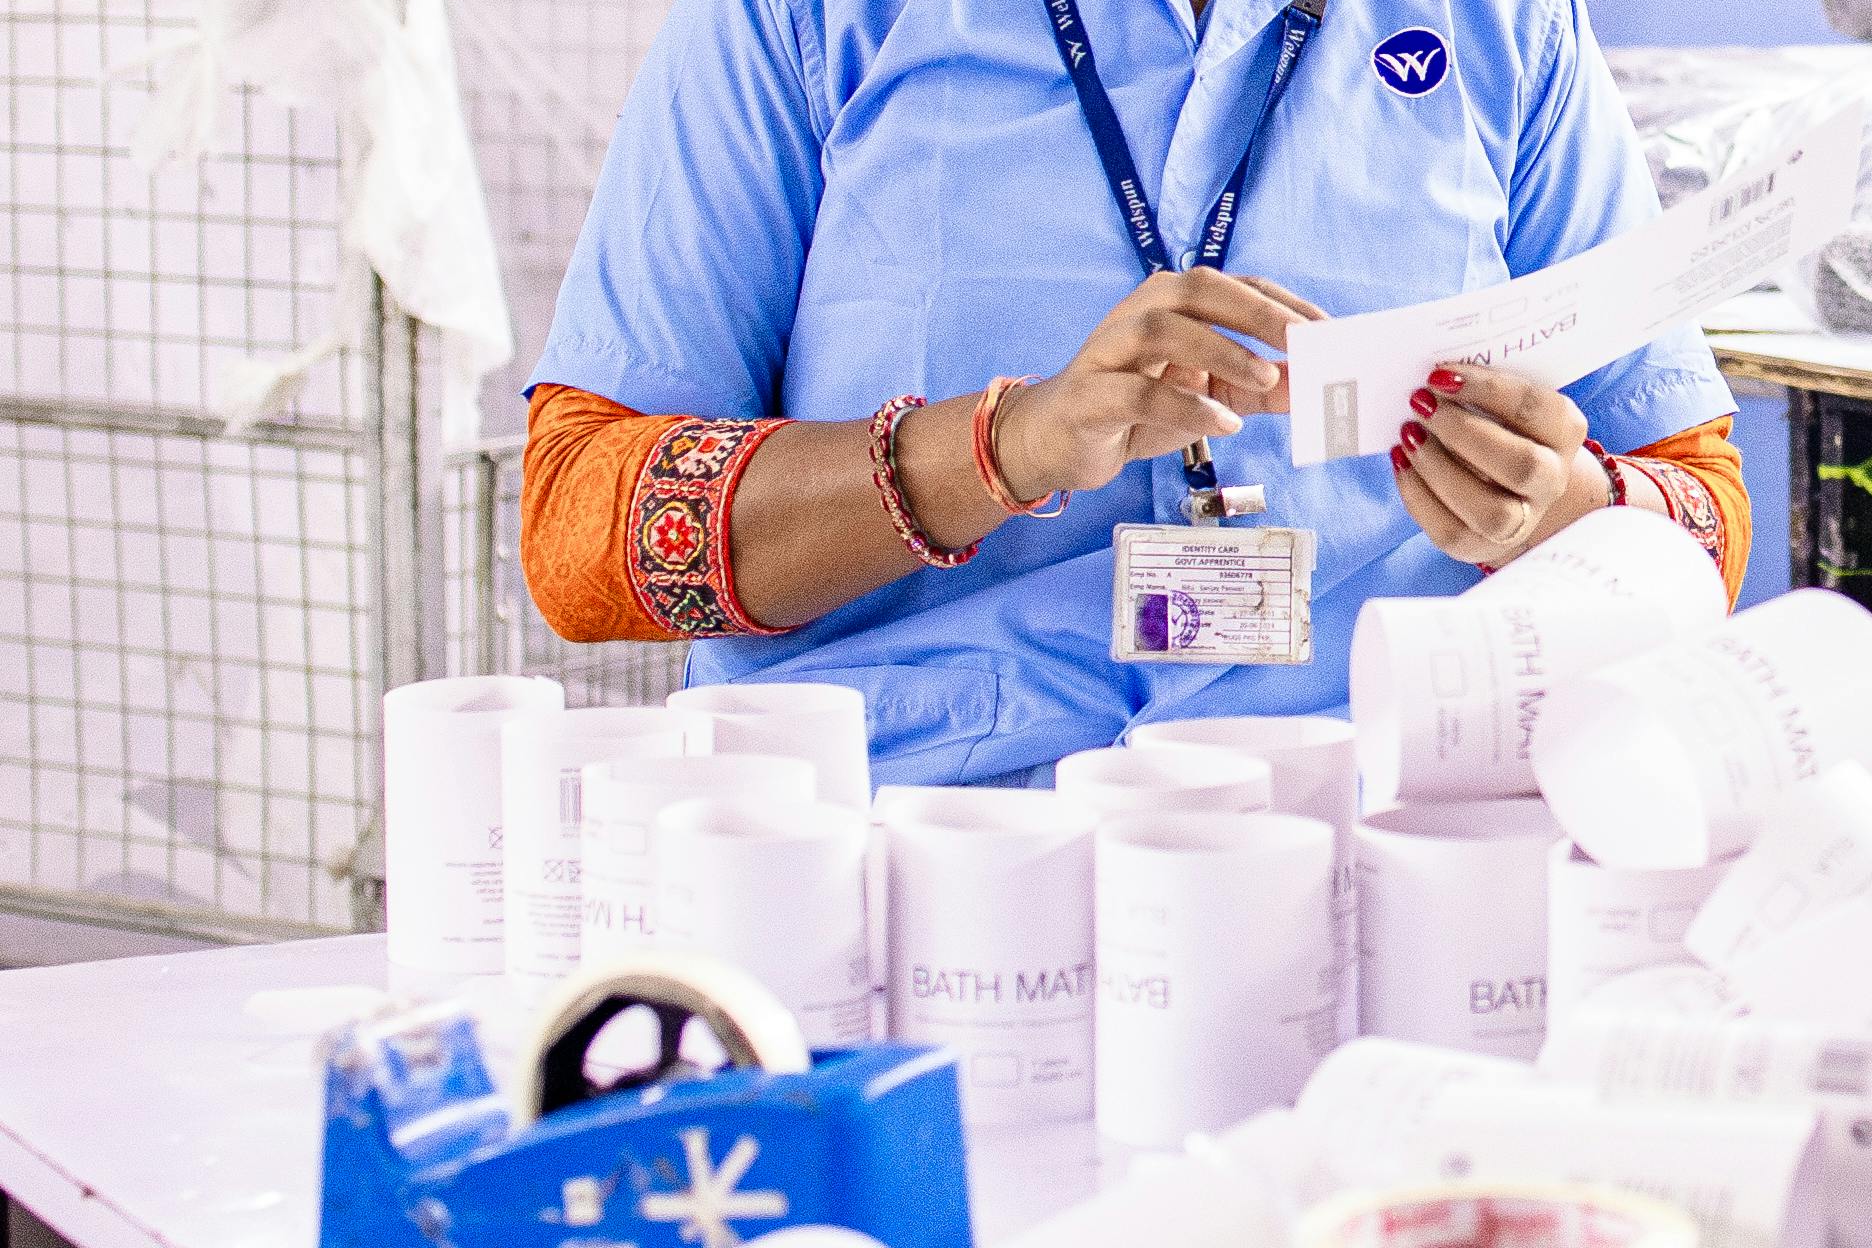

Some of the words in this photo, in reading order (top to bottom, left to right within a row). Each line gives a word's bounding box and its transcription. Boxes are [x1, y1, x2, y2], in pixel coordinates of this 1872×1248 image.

[1120, 178, 1154, 249] Welspun
[1202, 191, 1236, 260] Welspun
[1503, 313, 1578, 360] BATH
[1181, 545, 1217, 554] IDENTITY
[1218, 546, 1240, 554] CARD
[912, 964, 1002, 1004] BATH
[1015, 961, 1095, 1004] MAT
